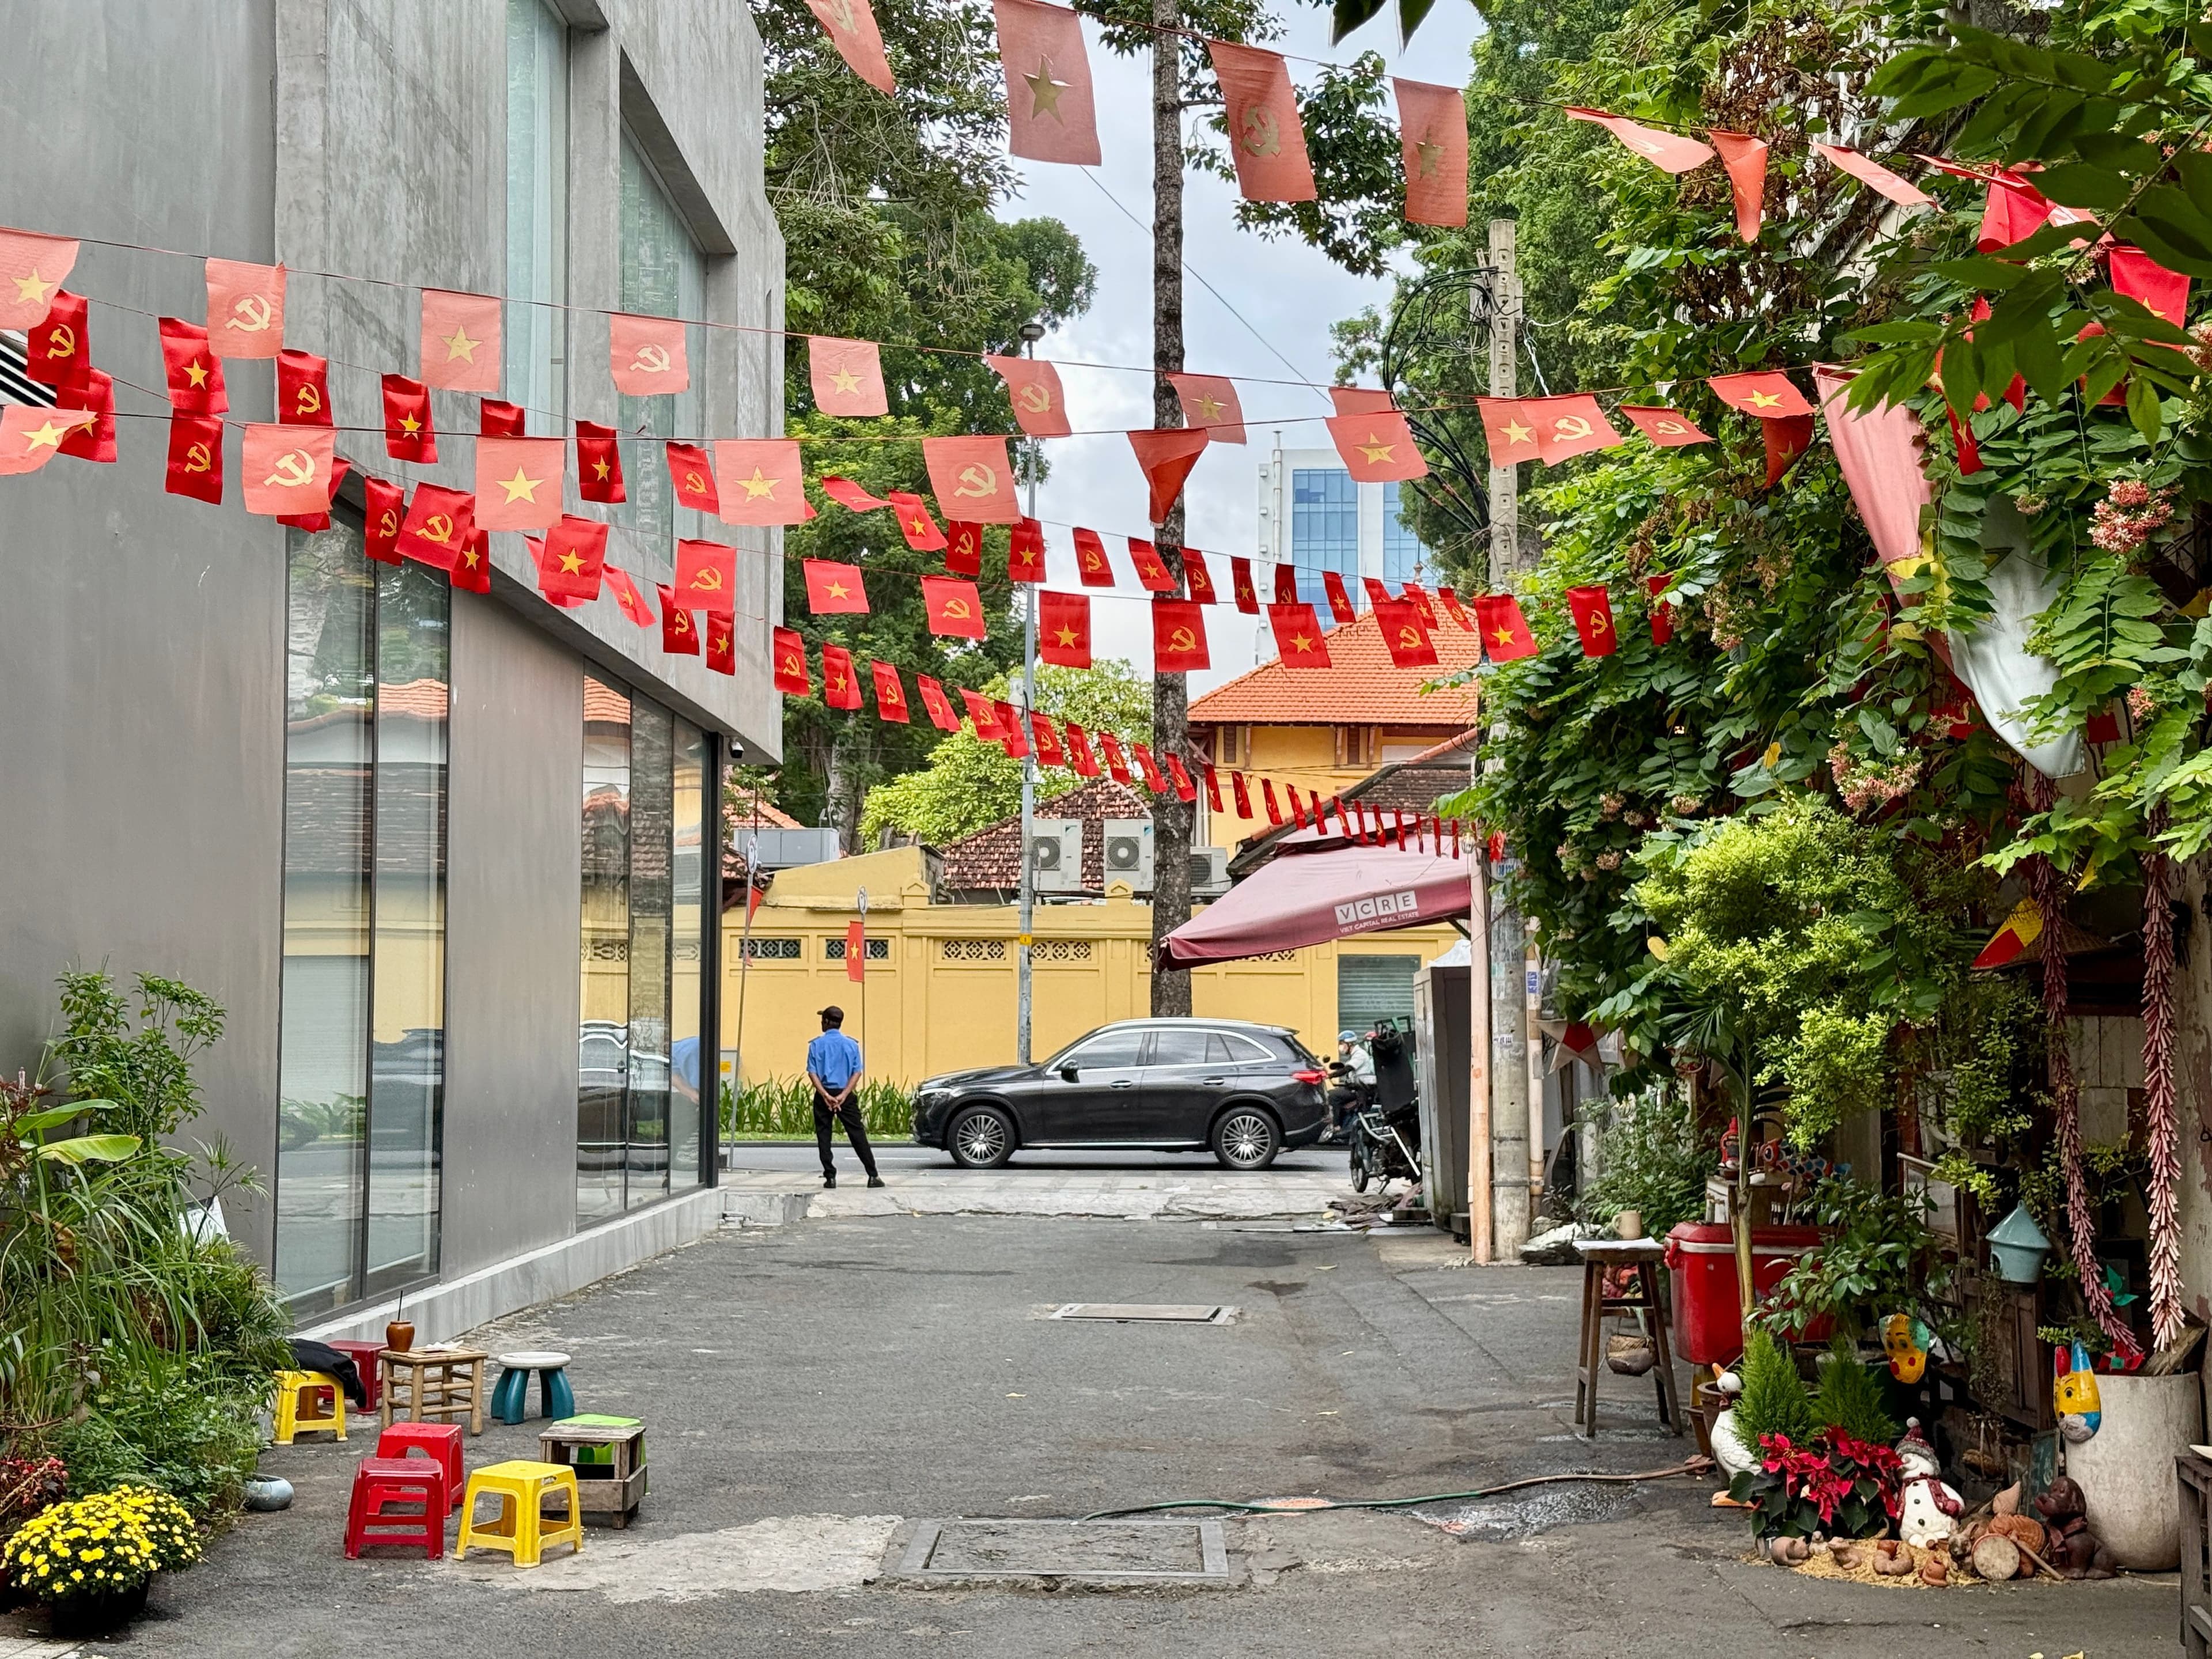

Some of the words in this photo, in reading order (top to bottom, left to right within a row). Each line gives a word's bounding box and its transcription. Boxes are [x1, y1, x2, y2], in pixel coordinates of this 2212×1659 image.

[1339, 895, 1411, 920] VCRE
[1354, 919, 1381, 930] CAPITAL
[1397, 911, 1419, 921] ESTATE
